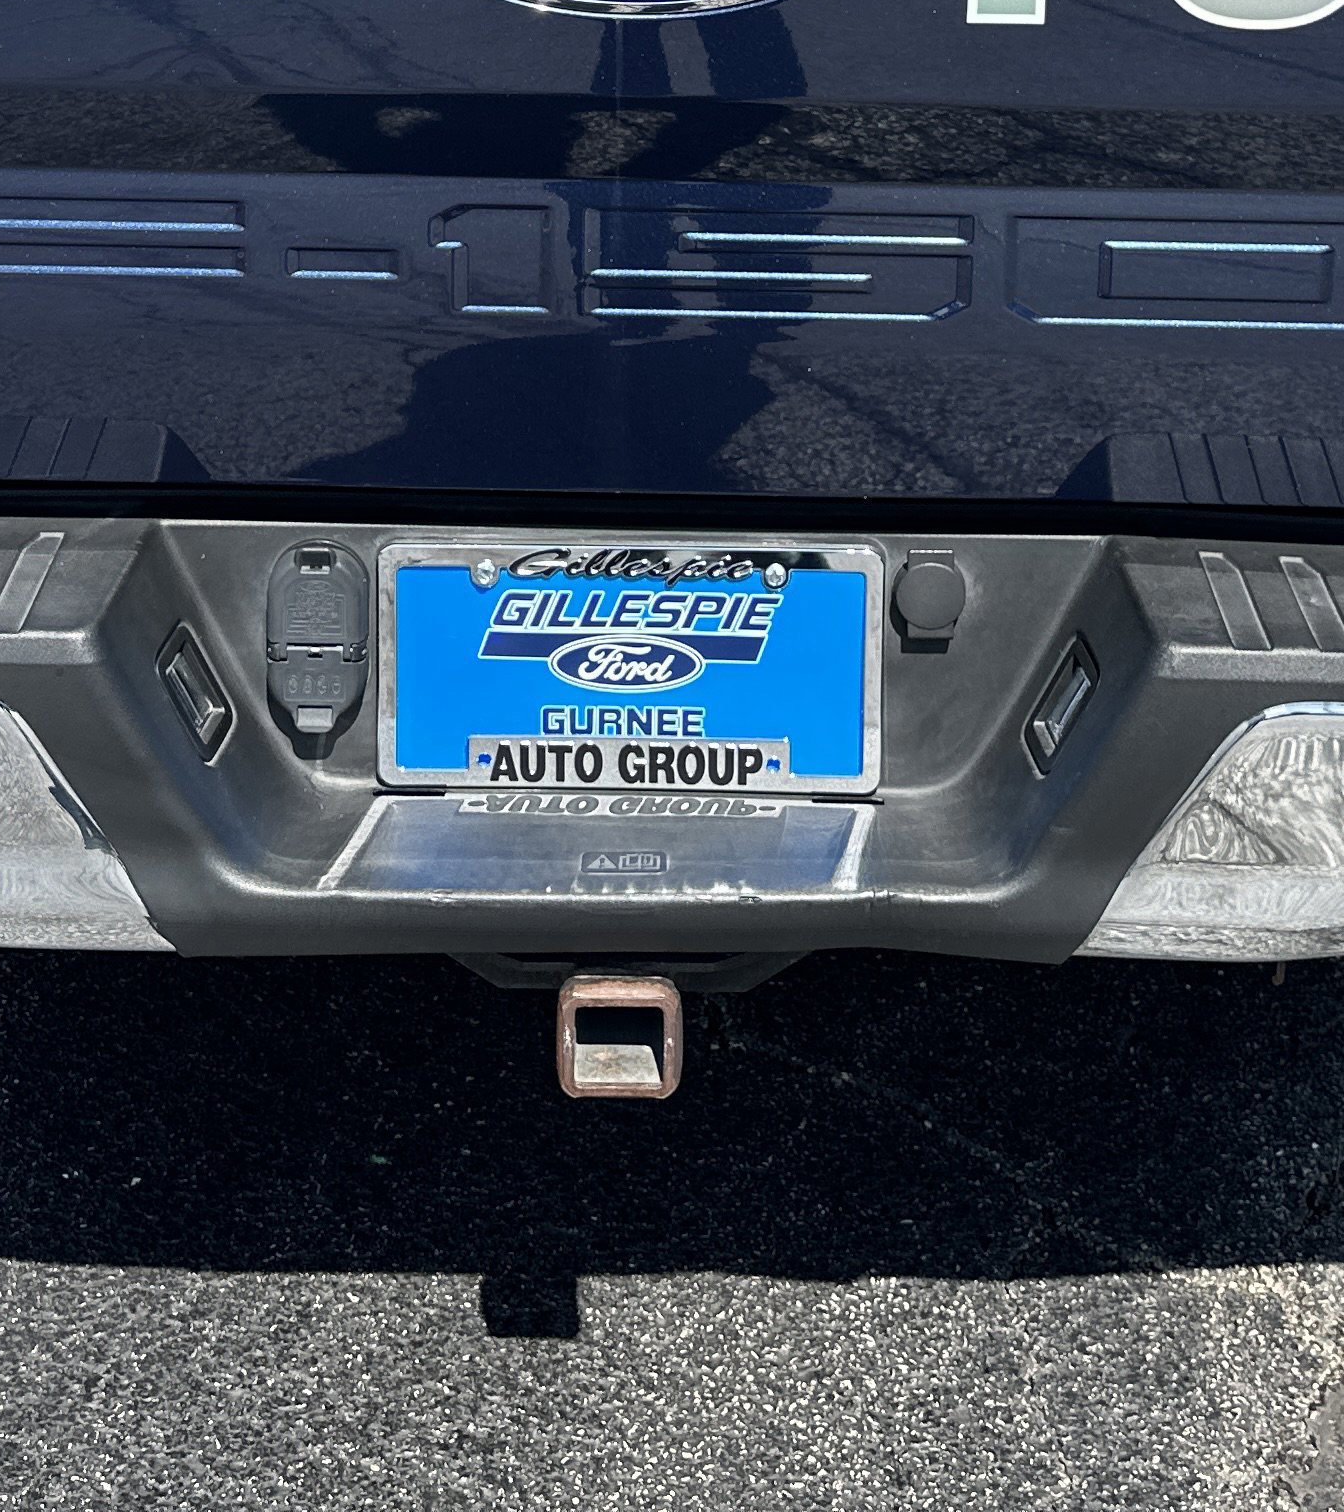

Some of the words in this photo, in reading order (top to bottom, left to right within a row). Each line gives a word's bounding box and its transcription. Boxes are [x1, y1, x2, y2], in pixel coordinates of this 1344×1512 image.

[509, 547, 754, 587] Gillespie
[490, 589, 784, 633] GILLESPIE
[577, 643, 675, 682] Ford
[540, 705, 706, 737] GURNEE
[490, 740, 603, 785] AUTO
[618, 740, 764, 786] GROUP
